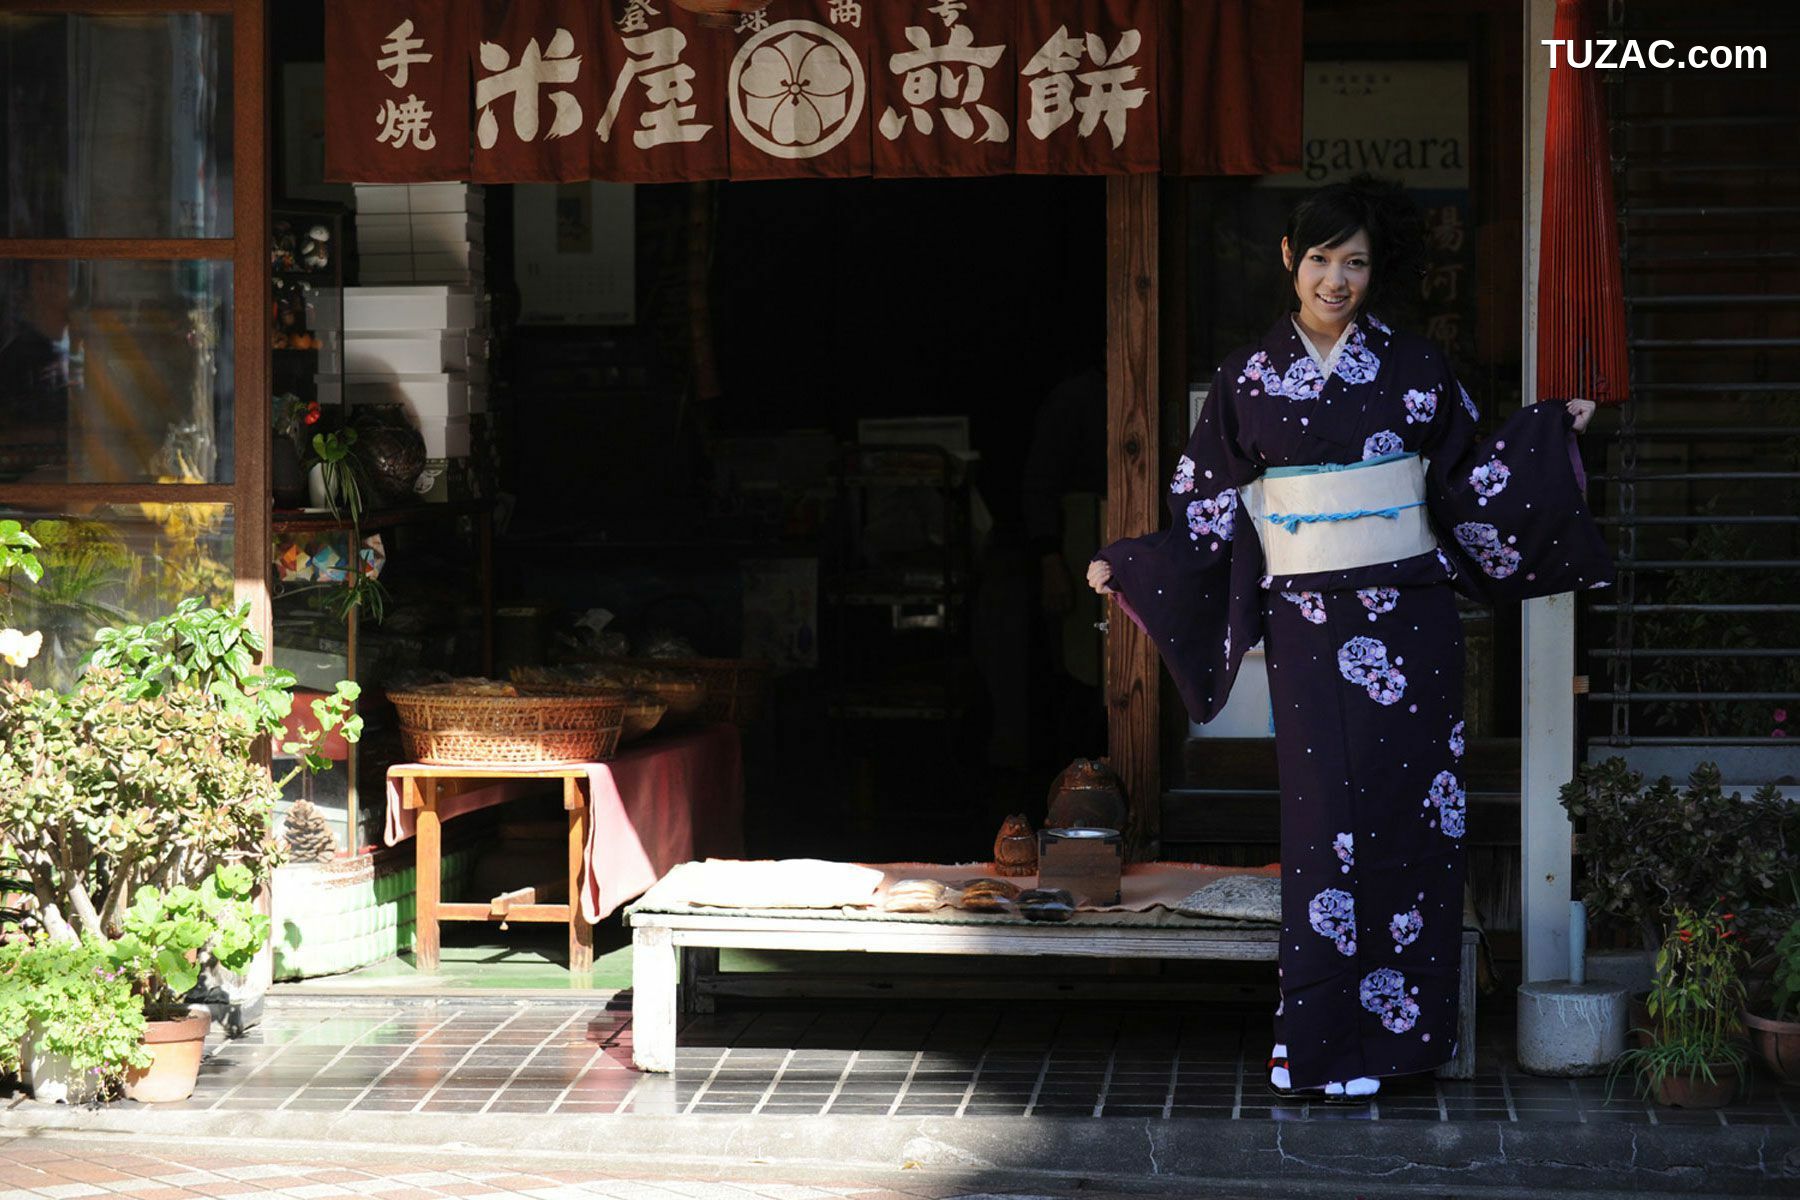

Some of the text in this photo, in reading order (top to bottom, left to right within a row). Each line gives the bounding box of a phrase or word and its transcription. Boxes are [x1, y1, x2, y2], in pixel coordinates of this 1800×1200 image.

[376, 19, 437, 151] 手焼
[475, 24, 1150, 150] 米屋 煎餅
[1306, 138, 1463, 181] gawara
